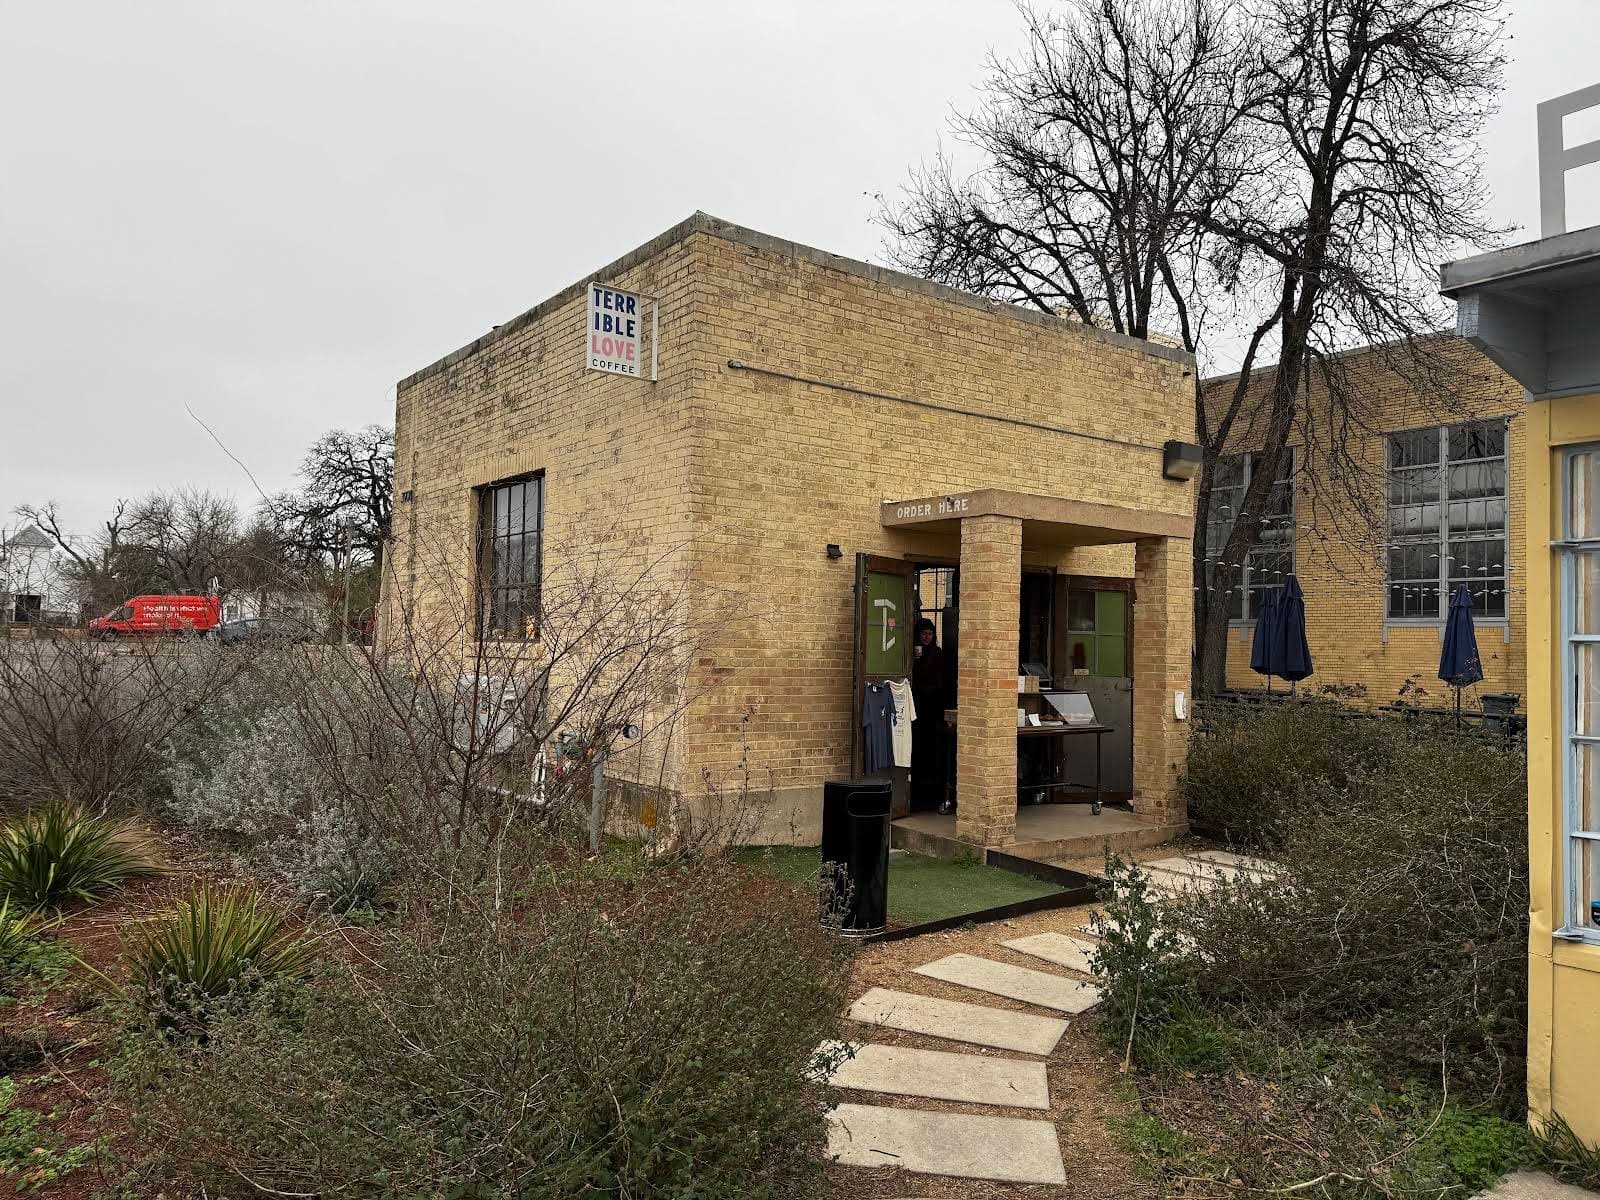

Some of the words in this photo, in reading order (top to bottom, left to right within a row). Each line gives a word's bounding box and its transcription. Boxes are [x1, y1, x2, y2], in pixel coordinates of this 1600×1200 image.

[593, 288, 636, 315] TERR
[594, 312, 636, 338] IBLE
[592, 335, 635, 361] LOVE
[592, 358, 635, 374] COFFEE
[897, 503, 932, 518] ORDER
[938, 498, 969, 514] HERE
